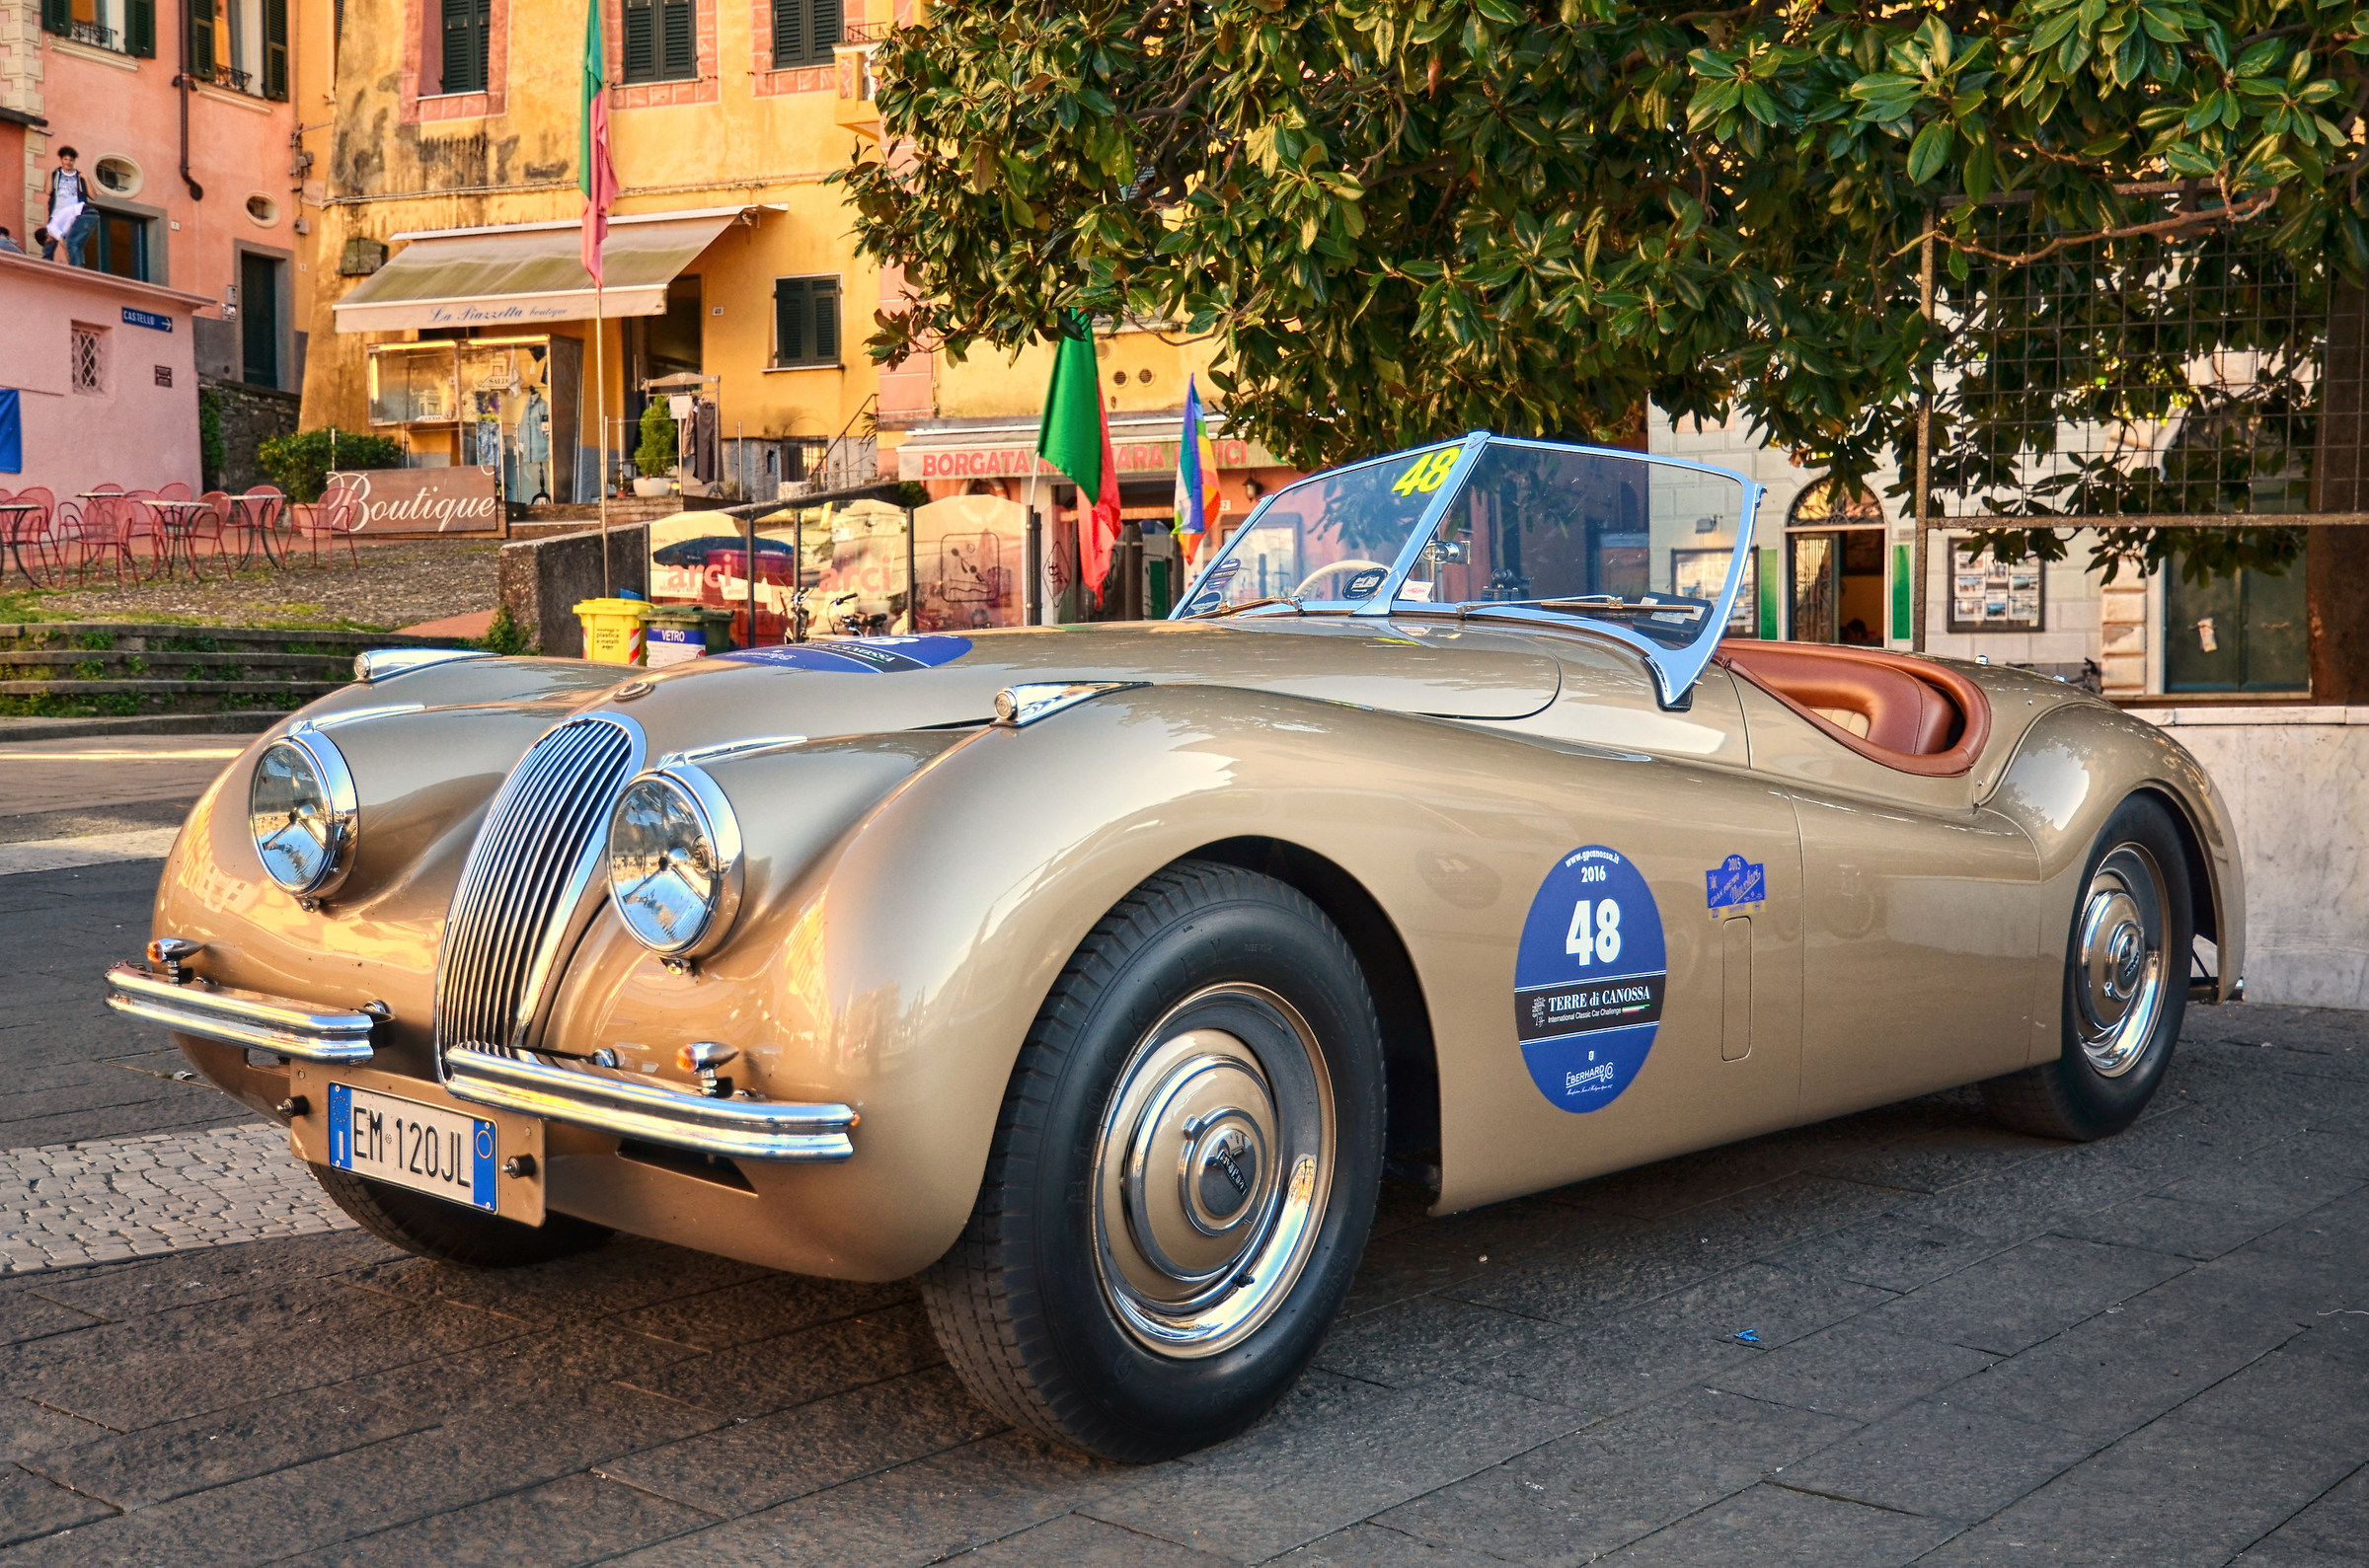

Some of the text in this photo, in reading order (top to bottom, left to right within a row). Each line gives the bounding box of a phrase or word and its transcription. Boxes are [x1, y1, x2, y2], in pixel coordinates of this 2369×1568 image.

[123, 310, 155, 326] CASTELLO
[923, 450, 1031, 476] BORGATA
[1392, 448, 1461, 497] 48
[327, 471, 497, 532] Boutique
[667, 554, 731, 589] arci
[818, 556, 891, 592] arci
[661, 631, 685, 642] VETRO
[1565, 850, 1620, 867] www.gpcanossa.it
[1581, 865, 1606, 883] 2016
[1566, 898, 1621, 966] 48
[1548, 993, 1587, 1012] TERRE
[1589, 991, 1599, 1007] di
[1602, 986, 1650, 1005] CANOSSA
[1548, 1011, 1574, 1023] International
[1575, 1009, 1591, 1019] Classic
[1591, 1008, 1600, 1017] Car
[353, 1106, 471, 1188] EM 120JL
